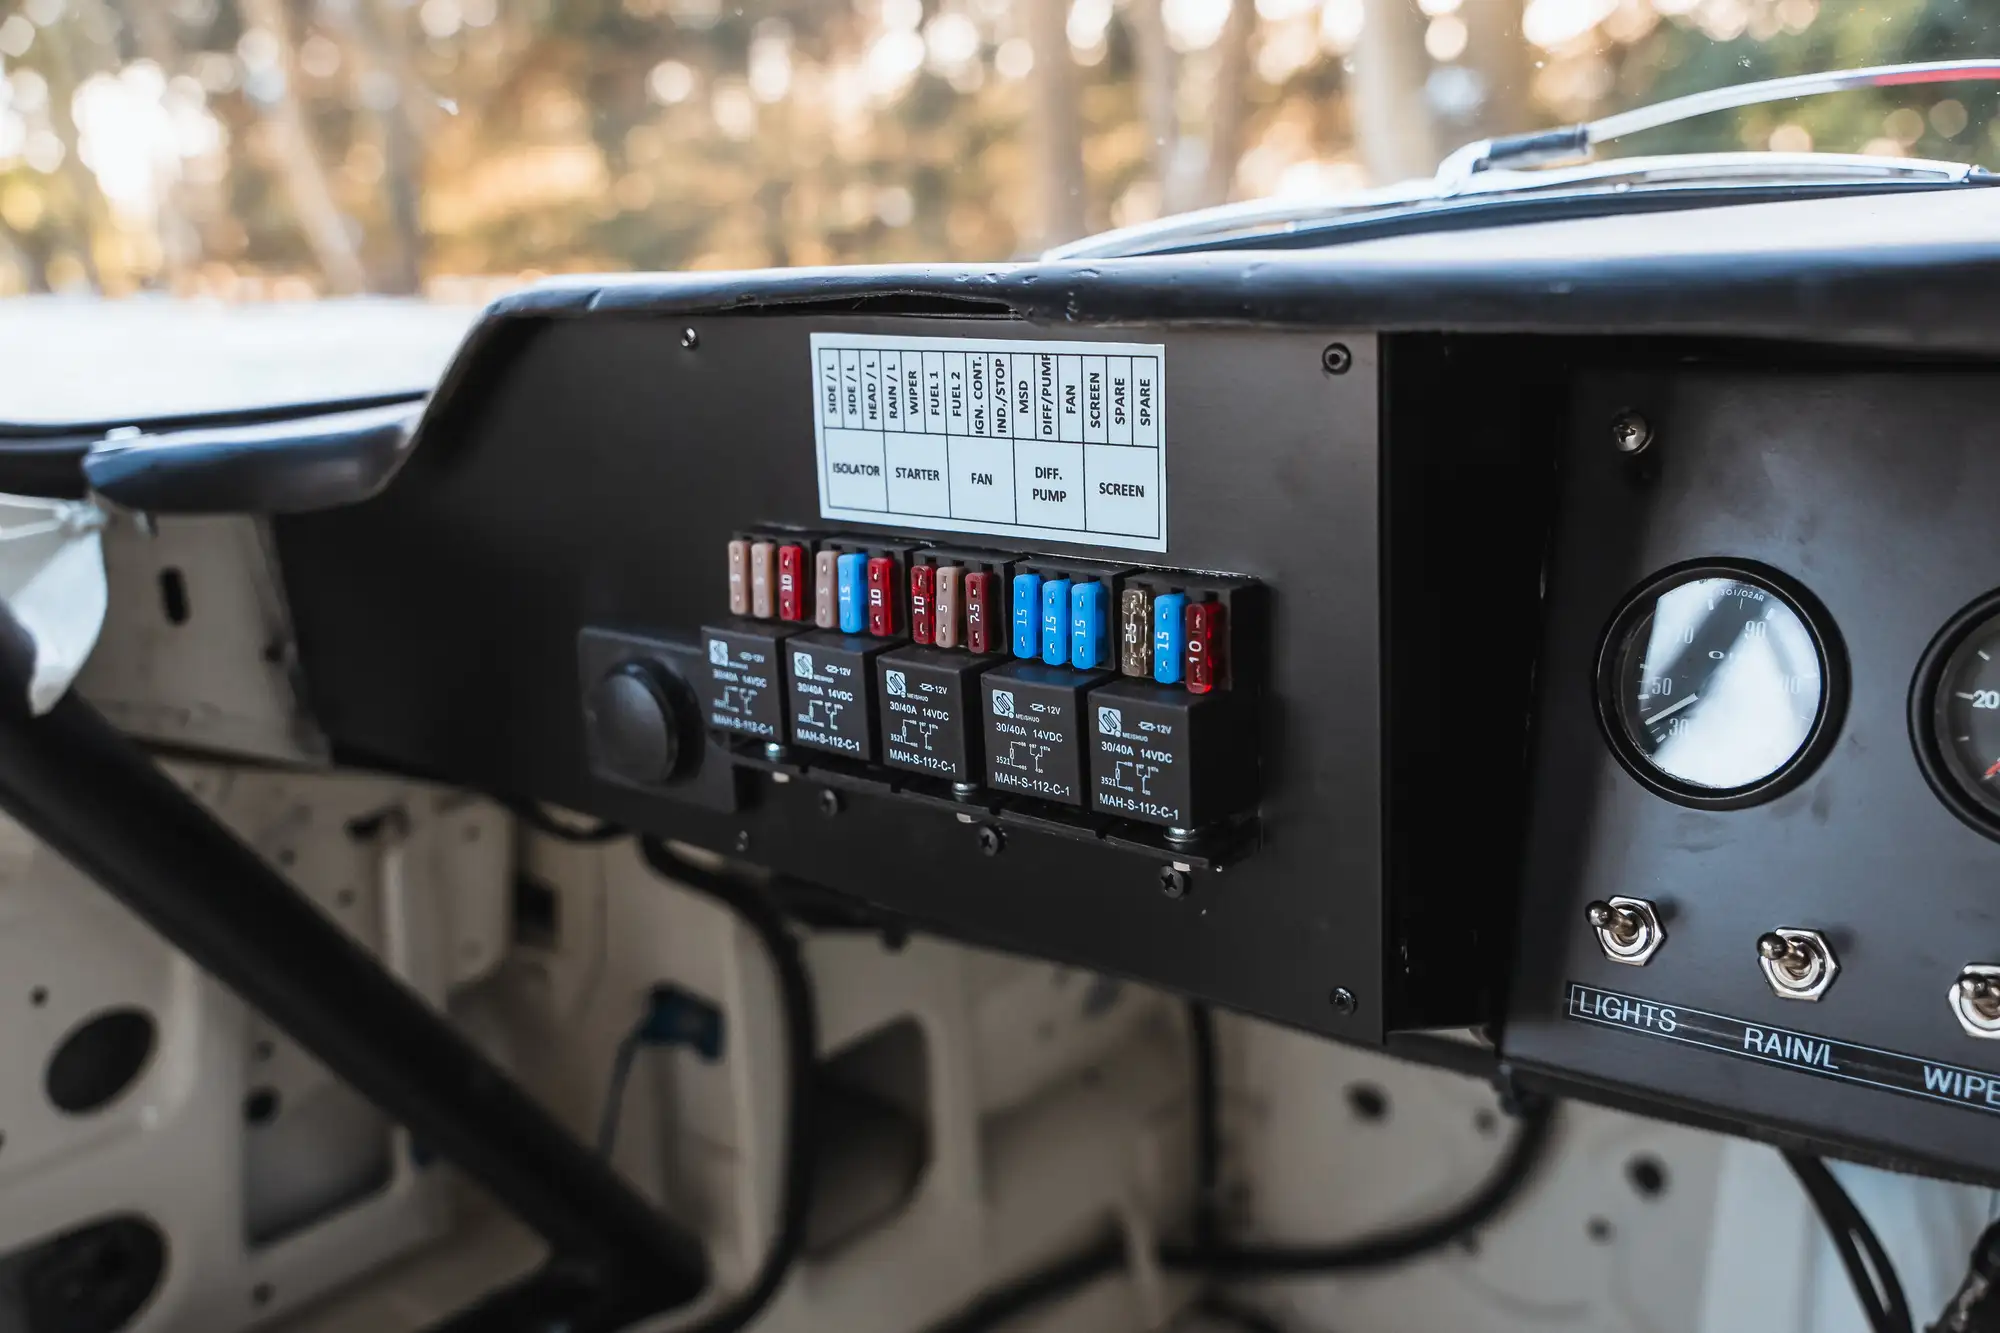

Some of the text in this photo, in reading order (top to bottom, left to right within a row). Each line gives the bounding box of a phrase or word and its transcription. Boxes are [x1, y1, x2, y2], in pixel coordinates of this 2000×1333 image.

[828, 386, 836, 414] SIDE
[848, 386, 857, 415] SIDE
[868, 383, 877, 419] HEAD
[888, 386, 898, 419] RAIN
[908, 371, 918, 415] WIPER
[930, 371, 940, 415] FUEL 1
[951, 372, 961, 416] FUEL 2
[973, 356, 984, 434] IGN. CONT.
[995, 359, 1008, 433] IND./STOP
[1019, 381, 1028, 413] MSD
[1066, 385, 1076, 414] FAN
[1090, 373, 1100, 428] SCREEN
[1115, 378, 1125, 425] SPARE
[1140, 379, 1151, 426] SPARE
[832, 463, 880, 477] ISOLATOR
[895, 467, 940, 481] STARTER
[971, 473, 993, 486] FAN
[1035, 467, 1062, 481] DIFF.
[1032, 489, 1067, 503] PUMP
[1099, 482, 1145, 498] SCREEN
[781, 574, 792, 592] 10
[871, 589, 882, 607] 10
[914, 596, 925, 615] 10
[938, 604, 947, 613] 5
[1017, 608, 1027, 625] 15
[1046, 616, 1056, 634] 15
[1075, 619, 1086, 638] 15
[1158, 631, 1169, 651] 15
[1189, 640, 1202, 664] 10
[839, 667, 851, 676] 12V
[828, 689, 853, 701] 14VDC
[935, 685, 948, 695] 12V
[1652, 677, 1672, 695] 50
[1972, 689, 1999, 709] 20
[889, 701, 949, 721] 30/40A 14VDC
[1047, 706, 1061, 715] 12V
[996, 722, 1063, 742] 30/40A 14VDC
[1157, 725, 1172, 734] 12V
[1669, 718, 1689, 735] 30
[797, 728, 859, 751] MAH-S-112-C-1
[889, 749, 955, 773] MAH-S-112-C-1
[996, 756, 1010, 765] 3521
[1101, 741, 1172, 763] 30/40A 14VDC
[995, 772, 1070, 796] MAH-S-112-C-1
[1101, 776, 1116, 786] 3521
[1099, 793, 1179, 820] MAH-S-112-C-1
[1579, 990, 2000, 1105] LIGHTS RAIN/L WIPE
